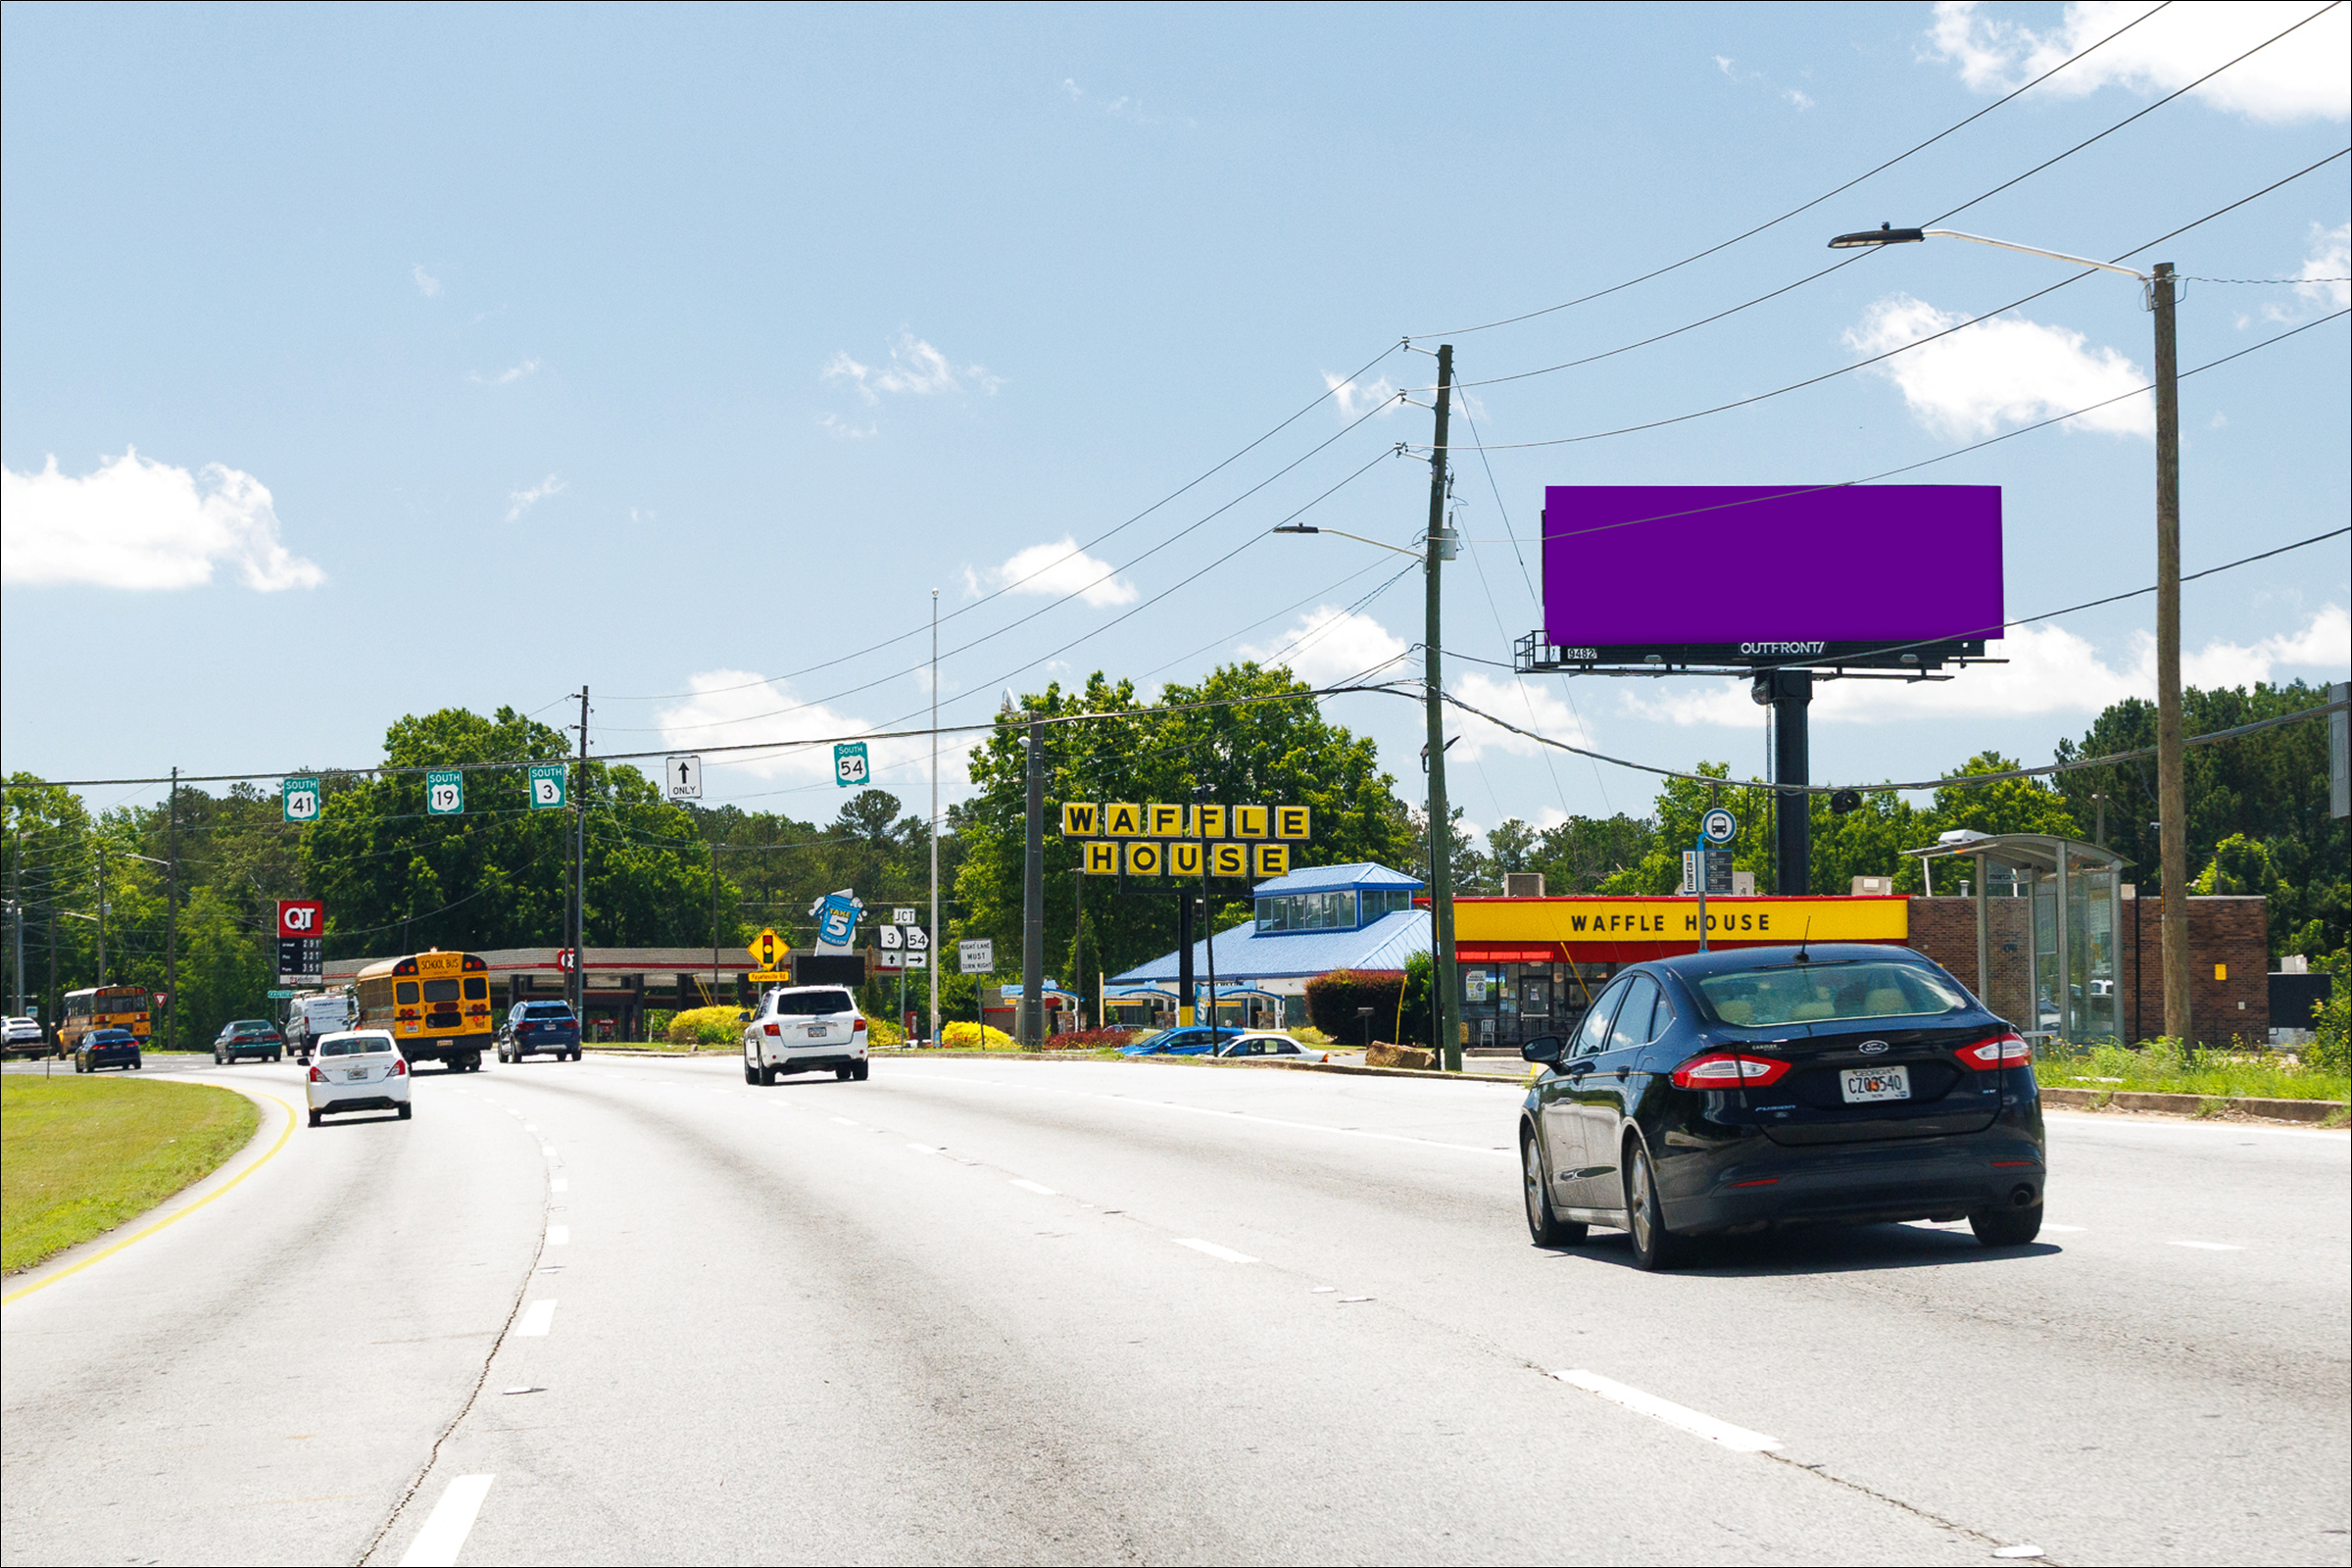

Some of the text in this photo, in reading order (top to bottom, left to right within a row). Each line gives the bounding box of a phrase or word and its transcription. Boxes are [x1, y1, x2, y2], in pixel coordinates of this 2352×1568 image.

[1569, 648, 1594, 659] 9482
[838, 746, 863, 755] SOUTH
[532, 768, 563, 777] SOUTH
[840, 760, 863, 775] 54
[429, 773, 461, 783] SOUTH
[286, 780, 317, 790] SOUTH
[673, 786, 697, 795] ONLY
[436, 790, 454, 806] 19
[543, 784, 553, 800] 3
[293, 797, 312, 812] 41
[1068, 808, 1303, 835] WAFFLE
[1092, 846, 1283, 872] HOUSE
[284, 906, 316, 930] QT
[829, 908, 852, 918] TAKE
[895, 910, 914, 921] JCT
[826, 914, 850, 937] 5
[1571, 914, 1770, 931] WAFFLE HOUSE
[887, 933, 895, 945] 3
[909, 935, 926, 946] 54
[421, 958, 460, 970] SCHOOL BUS
